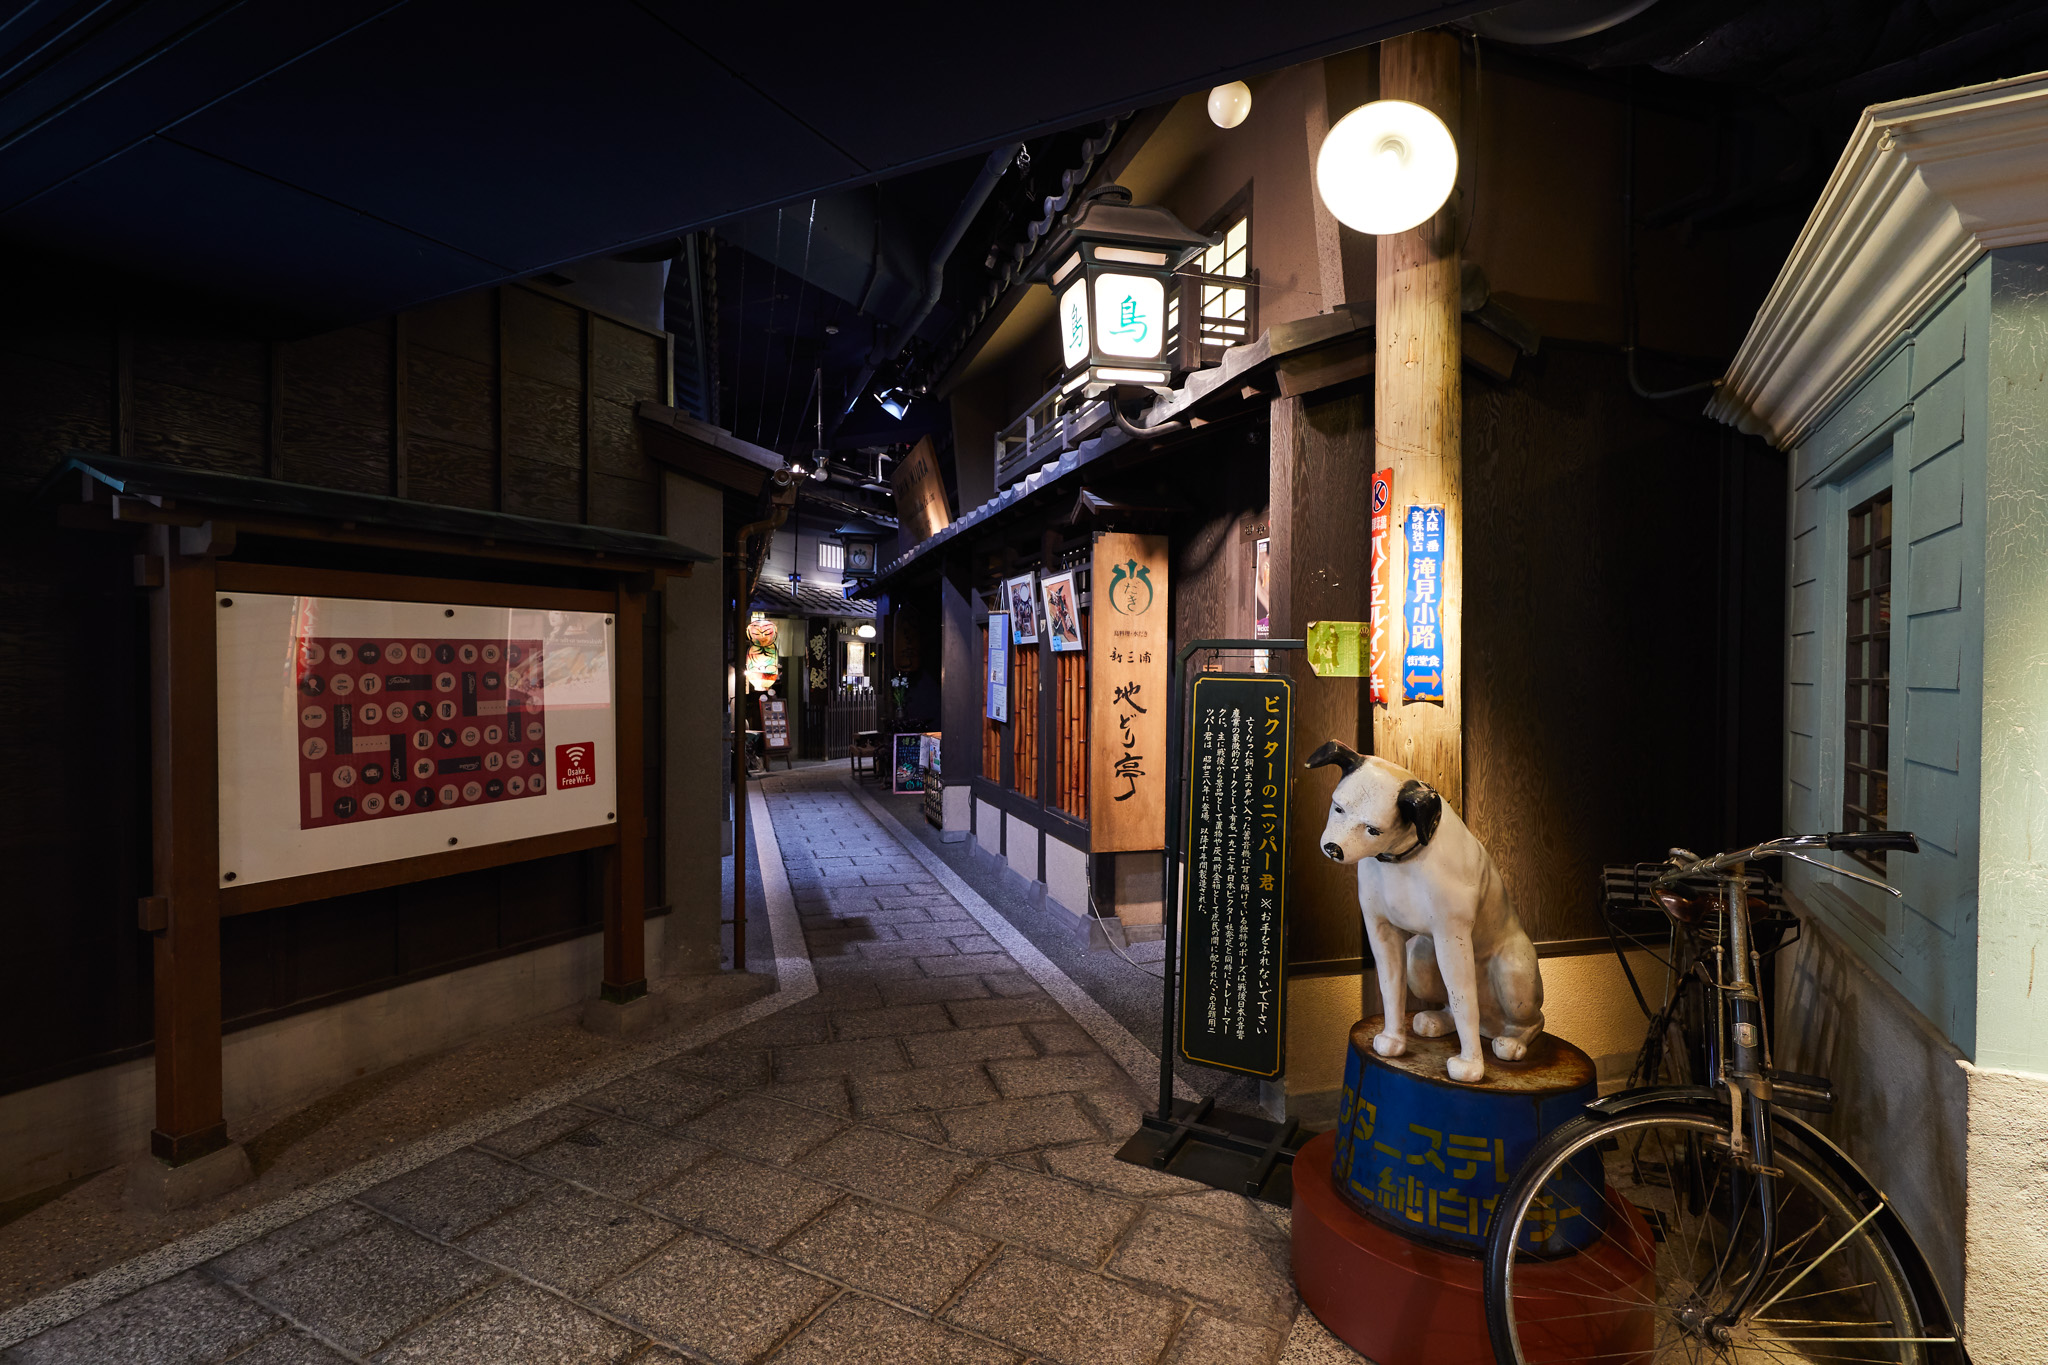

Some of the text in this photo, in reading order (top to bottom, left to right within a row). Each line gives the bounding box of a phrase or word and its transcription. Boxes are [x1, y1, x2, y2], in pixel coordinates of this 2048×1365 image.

[1069, 303, 1084, 349] 鳥
[1108, 294, 1148, 343] 鳥
[1411, 510, 1425, 552] 美味独占
[1426, 510, 1440, 552] 大阪一番
[1412, 557, 1436, 649] 滝見小路
[1109, 647, 1152, 664] 新三浦
[1112, 681, 1148, 802] 地どり亭
[561, 776, 576, 786] Free
[567, 767, 586, 777] Osaka
[1258, 695, 1280, 892] ビクターのニッパー君
